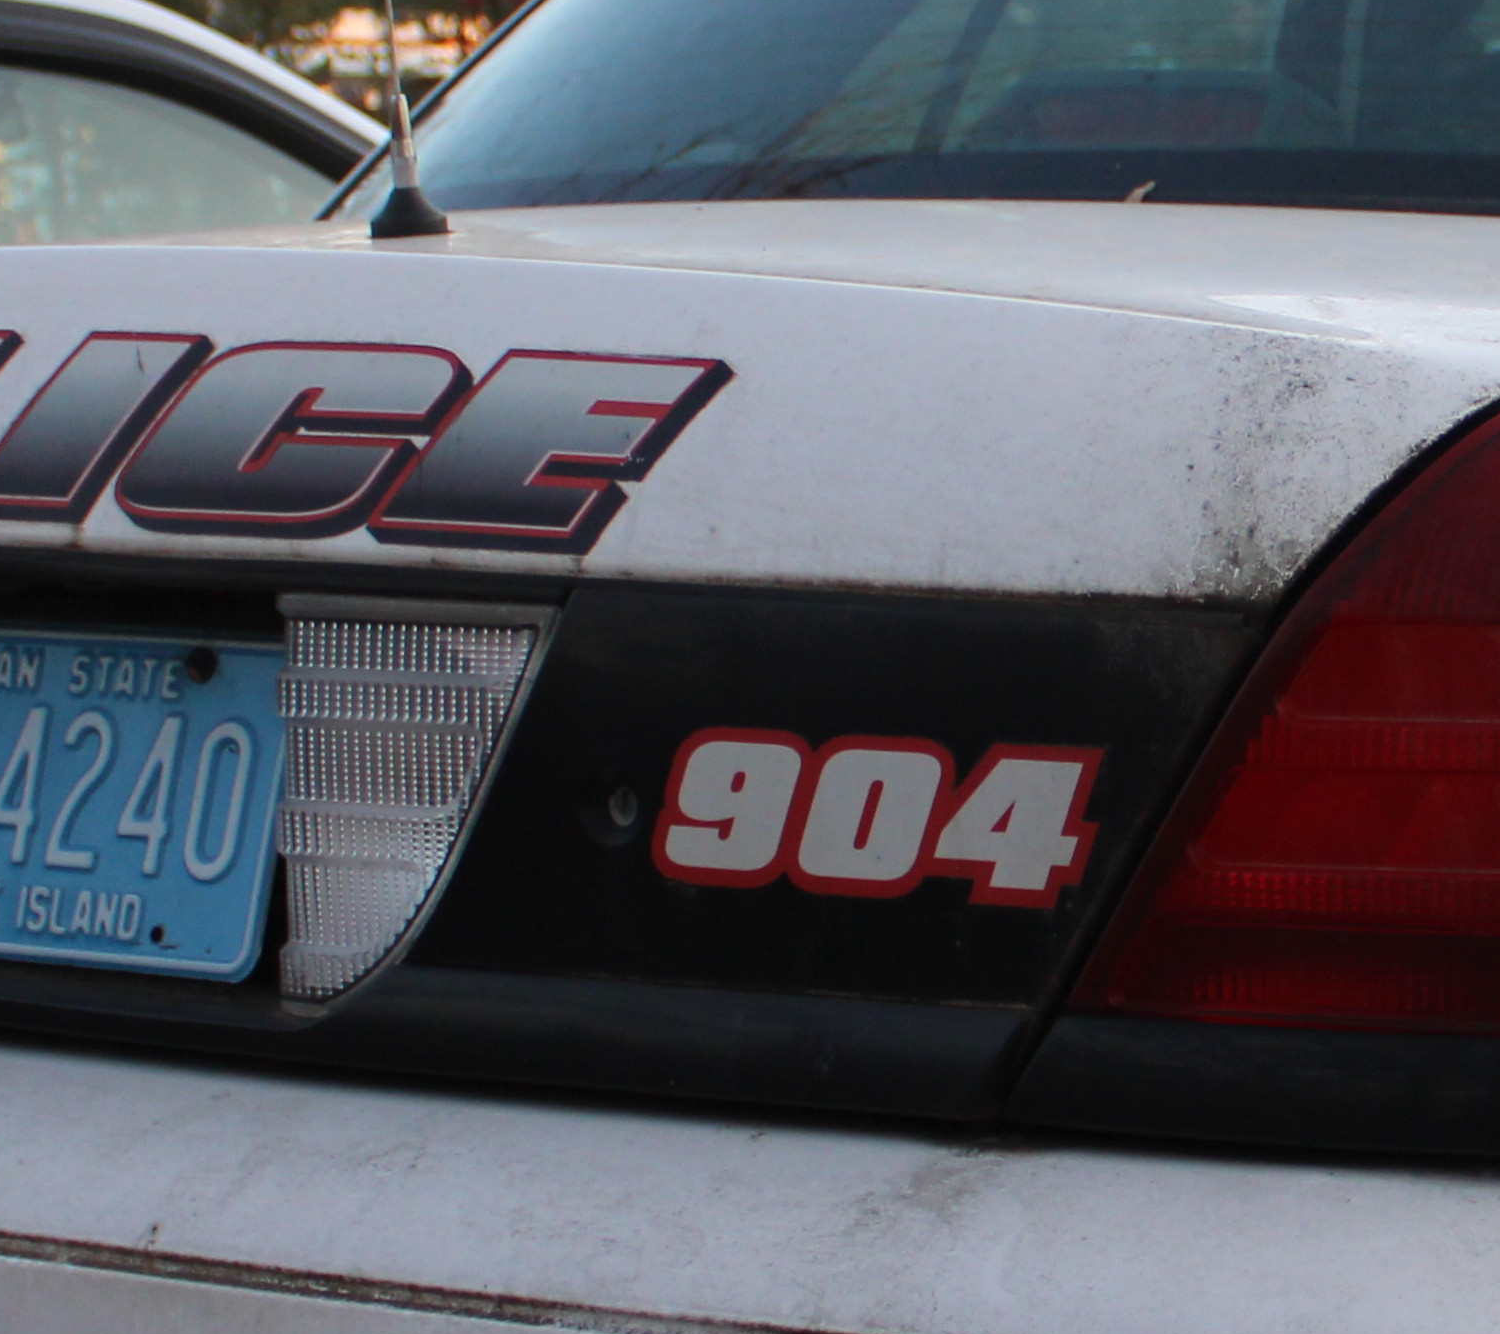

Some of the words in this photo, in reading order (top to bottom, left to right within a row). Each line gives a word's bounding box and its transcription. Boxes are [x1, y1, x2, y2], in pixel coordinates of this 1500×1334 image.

[67, 654, 186, 701] STATE
[656, 731, 1100, 905] 904
[16, 886, 143, 942] ISLAND
